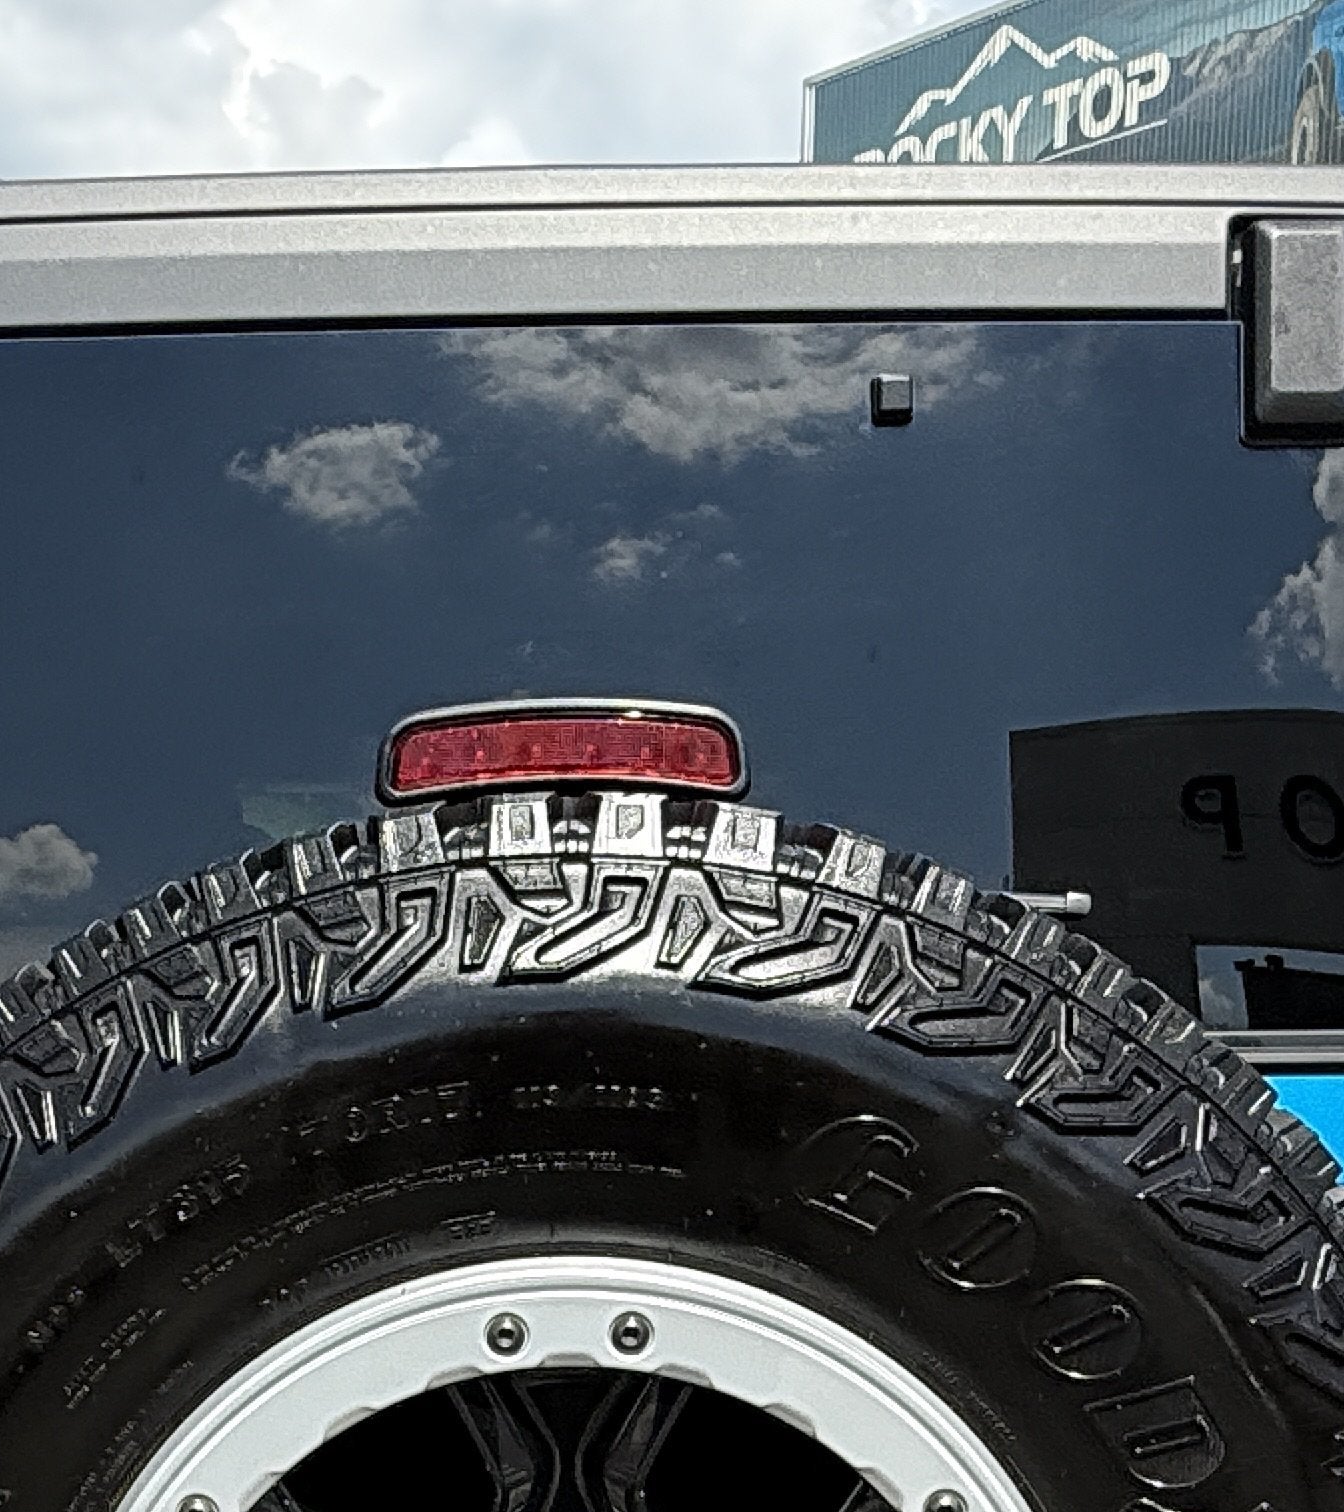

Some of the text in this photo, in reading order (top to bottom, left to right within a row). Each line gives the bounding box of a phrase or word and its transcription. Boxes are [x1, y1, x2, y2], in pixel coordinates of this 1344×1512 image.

[853, 52, 1170, 162] OCKY TOP
[797, 1113, 1227, 1489] GOOD
